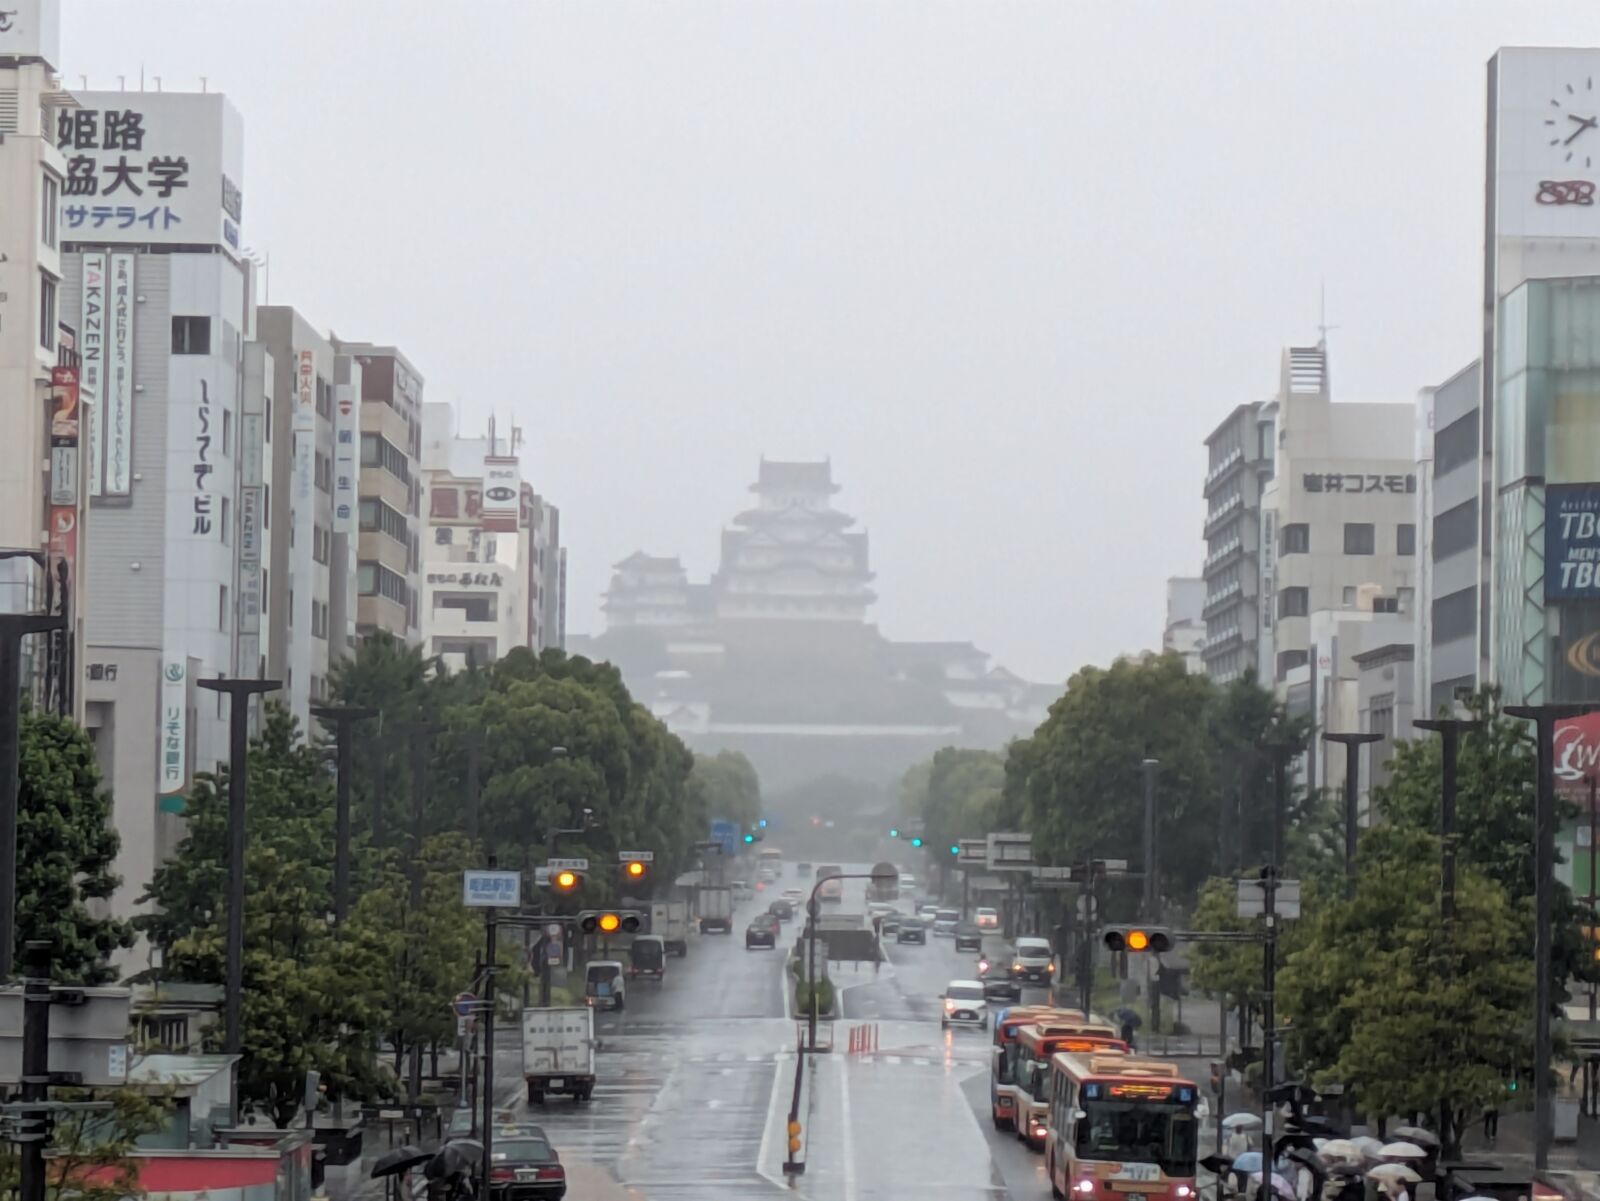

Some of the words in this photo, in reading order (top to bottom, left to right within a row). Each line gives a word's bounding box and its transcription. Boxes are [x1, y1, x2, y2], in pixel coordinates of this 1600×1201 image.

[57, 108, 146, 151] 姫路
[64, 204, 182, 230] サテライト
[85, 258, 102, 361] TAKAZEN
[86, 663, 118, 682] 銀行
[165, 706, 181, 781] りそな銀行
